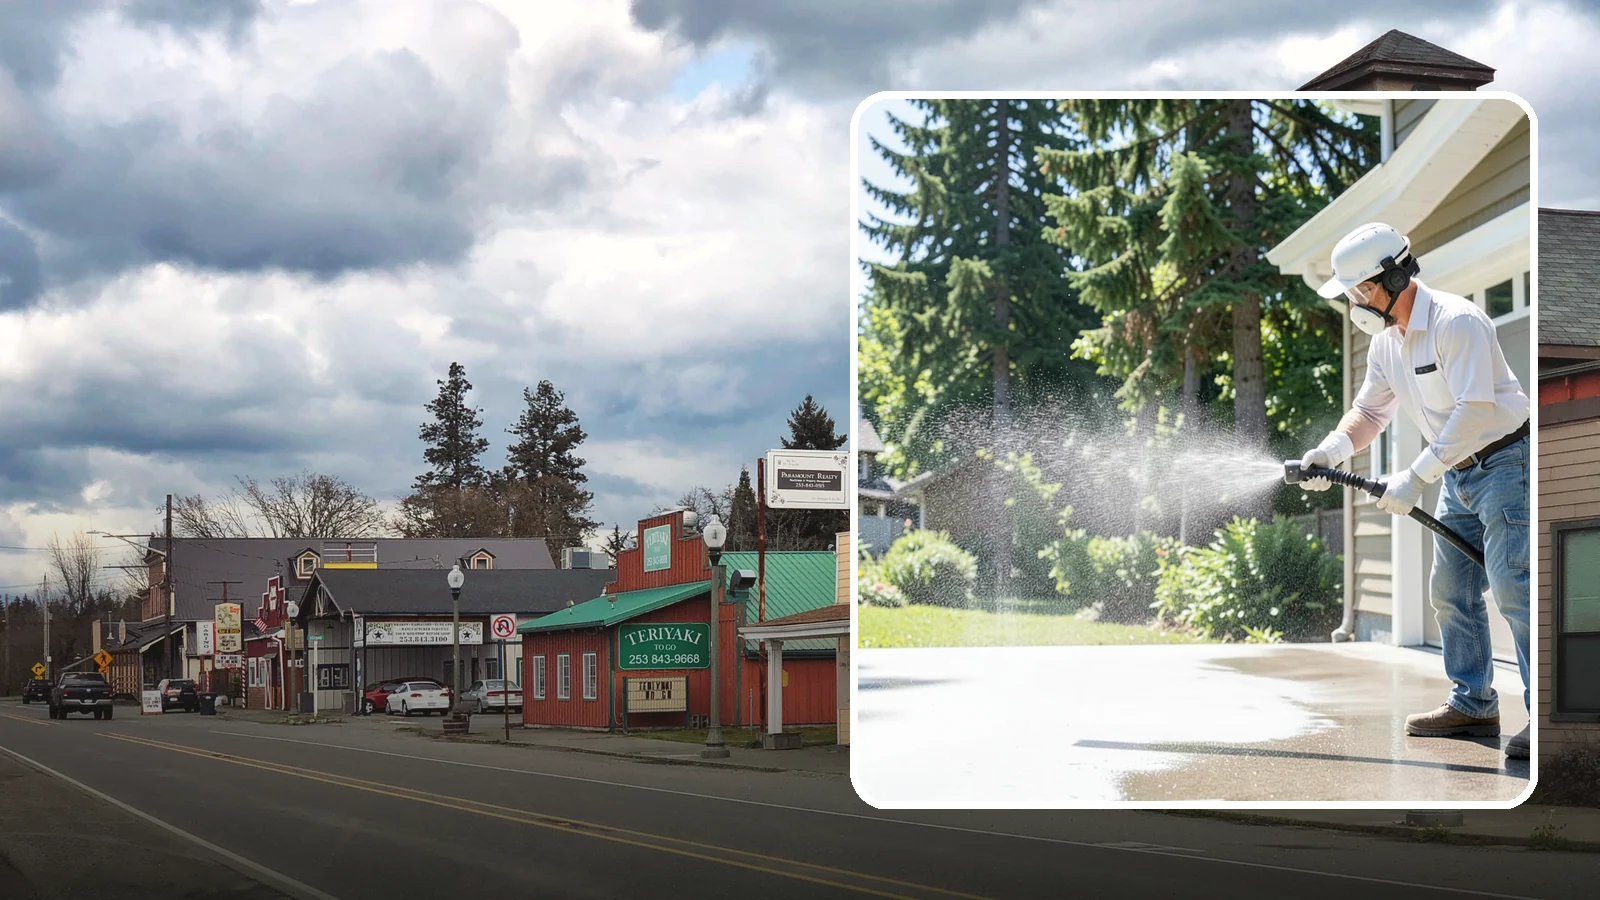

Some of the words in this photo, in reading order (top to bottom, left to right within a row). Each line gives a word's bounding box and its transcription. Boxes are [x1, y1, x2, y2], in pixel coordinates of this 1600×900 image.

[781, 471, 815, 479] PARAMOUNT
[817, 472, 839, 480] REALTY
[625, 627, 702, 646] TERIYAKI
[629, 654, 649, 665] 253
[651, 653, 700, 664] 843-9668
